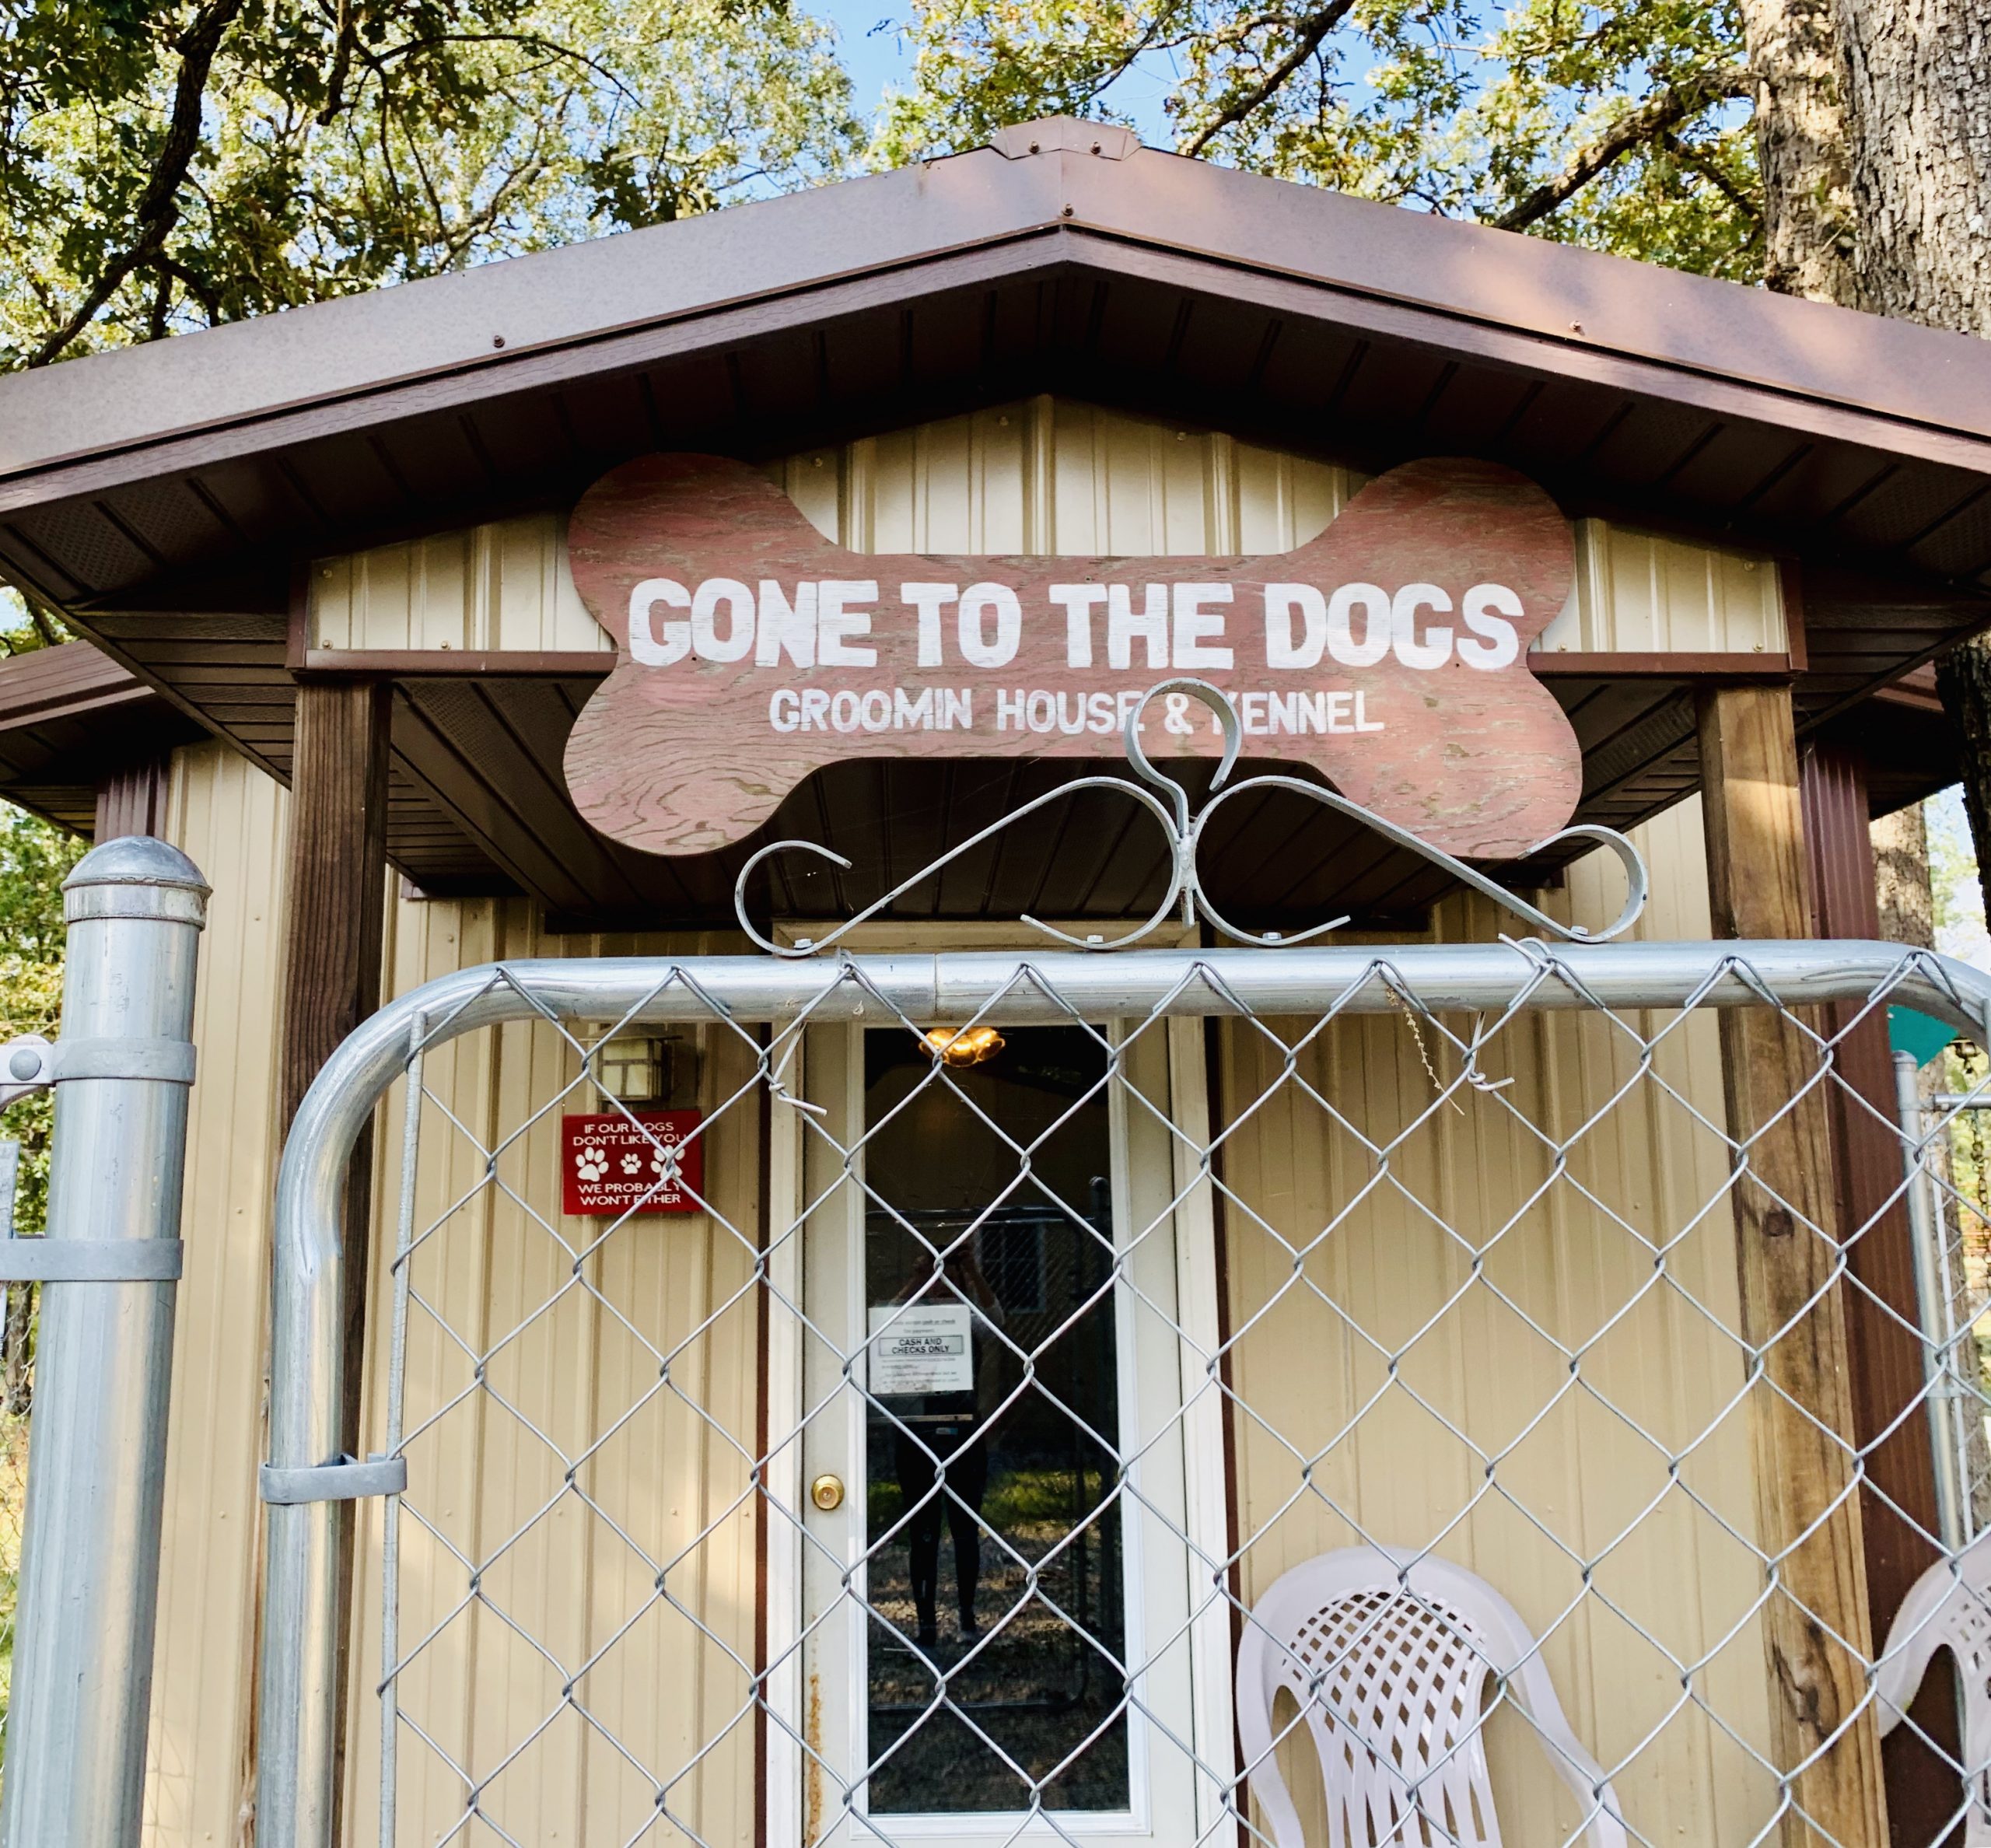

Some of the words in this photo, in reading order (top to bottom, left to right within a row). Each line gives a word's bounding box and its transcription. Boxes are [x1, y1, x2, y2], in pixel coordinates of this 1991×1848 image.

[628, 577, 879, 669] GONE
[900, 582, 1023, 668] TO
[1048, 583, 1234, 670] THE
[1265, 582, 1524, 670] DOGS
[769, 687, 972, 733] GROOMIN
[997, 688, 1146, 734] HOUSE
[1164, 691, 1194, 735] &
[584, 1124, 595, 1134] IF
[598, 1123, 629, 1133] OUR
[572, 1136, 618, 1146] DON'T
[621, 1134, 651, 1145] LIKE
[578, 1184, 602, 1194] WE
[579, 1195, 631, 1206] WON'T
[633, 1194, 681, 1205] ETHER
[898, 1338, 922, 1346] CASH
[891, 1346, 926, 1354] CHECKS
